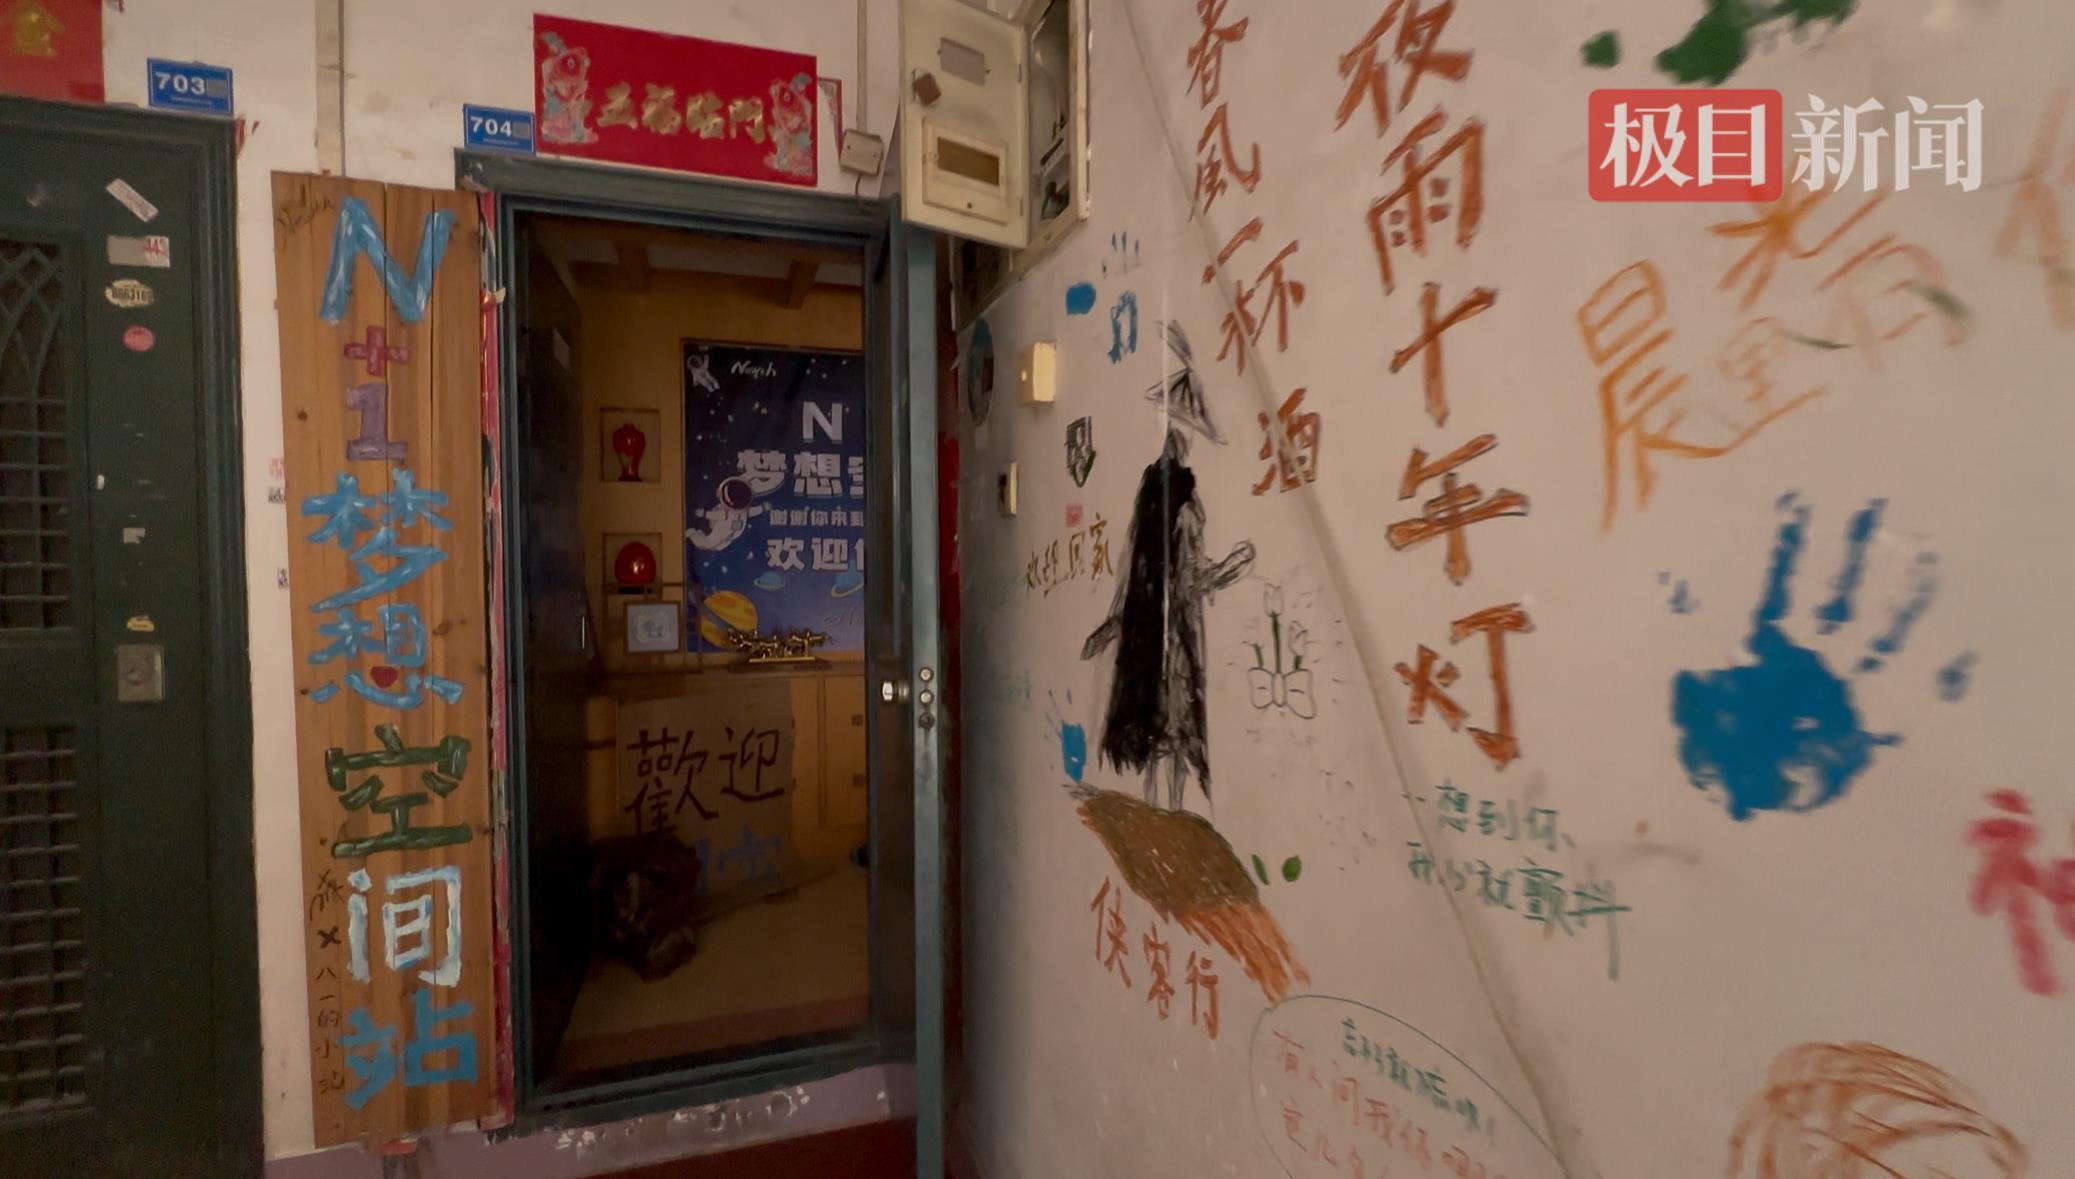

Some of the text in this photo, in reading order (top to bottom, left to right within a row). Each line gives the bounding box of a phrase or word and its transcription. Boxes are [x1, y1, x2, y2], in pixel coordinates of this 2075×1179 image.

[154, 71, 206, 96] 703
[470, 116, 512, 137] 704
[766, 537, 864, 571] 欢迎
